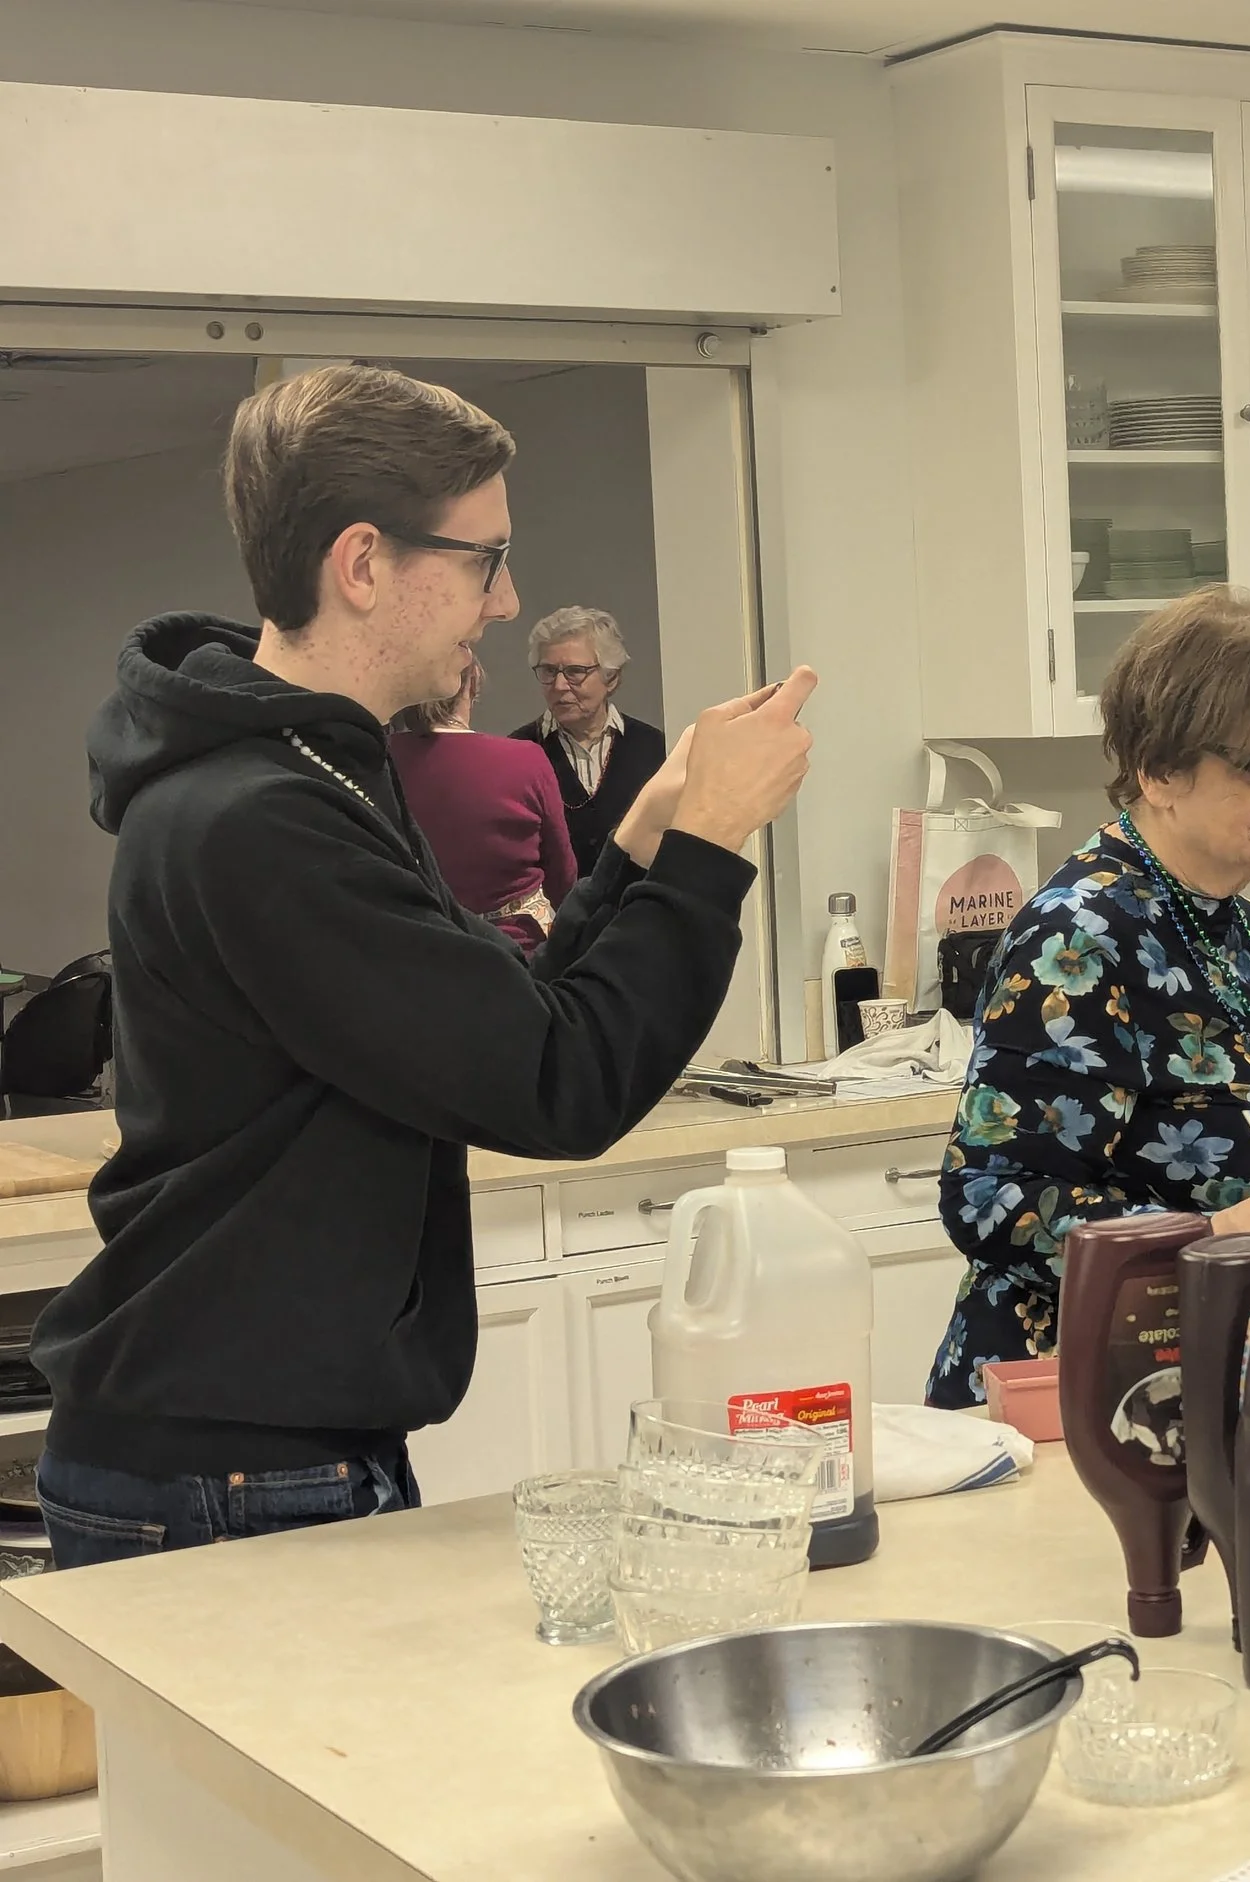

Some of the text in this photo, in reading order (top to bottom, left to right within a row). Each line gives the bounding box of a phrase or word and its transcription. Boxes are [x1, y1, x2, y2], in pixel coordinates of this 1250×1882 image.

[950, 891, 1014, 914] MARINE
[962, 912, 1004, 928] LAYER
[743, 1397, 779, 1411] Pearl
[798, 1405, 836, 1422] Original
